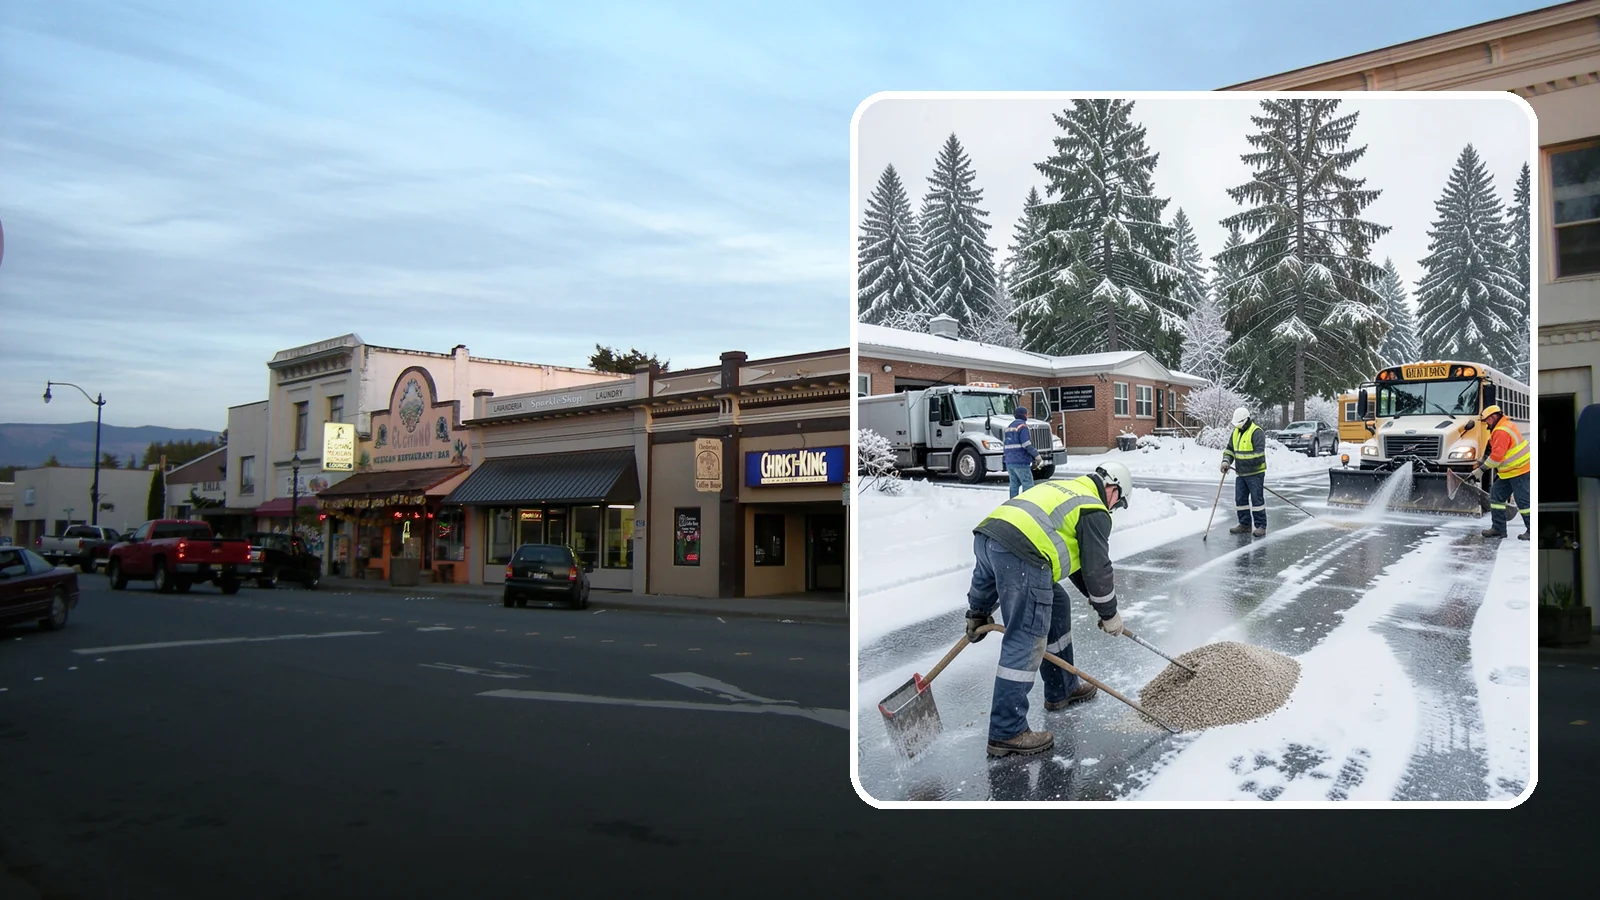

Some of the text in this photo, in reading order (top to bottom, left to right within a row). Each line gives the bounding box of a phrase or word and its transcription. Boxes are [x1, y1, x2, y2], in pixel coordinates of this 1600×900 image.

[561, 394, 583, 404] Shop
[595, 389, 623, 400] LAUNDRY
[493, 402, 522, 413] LAVANDERIA
[397, 451, 433, 462] RESTAURANT
[437, 450, 450, 459] BAR
[761, 450, 827, 478] CHRIST KING
